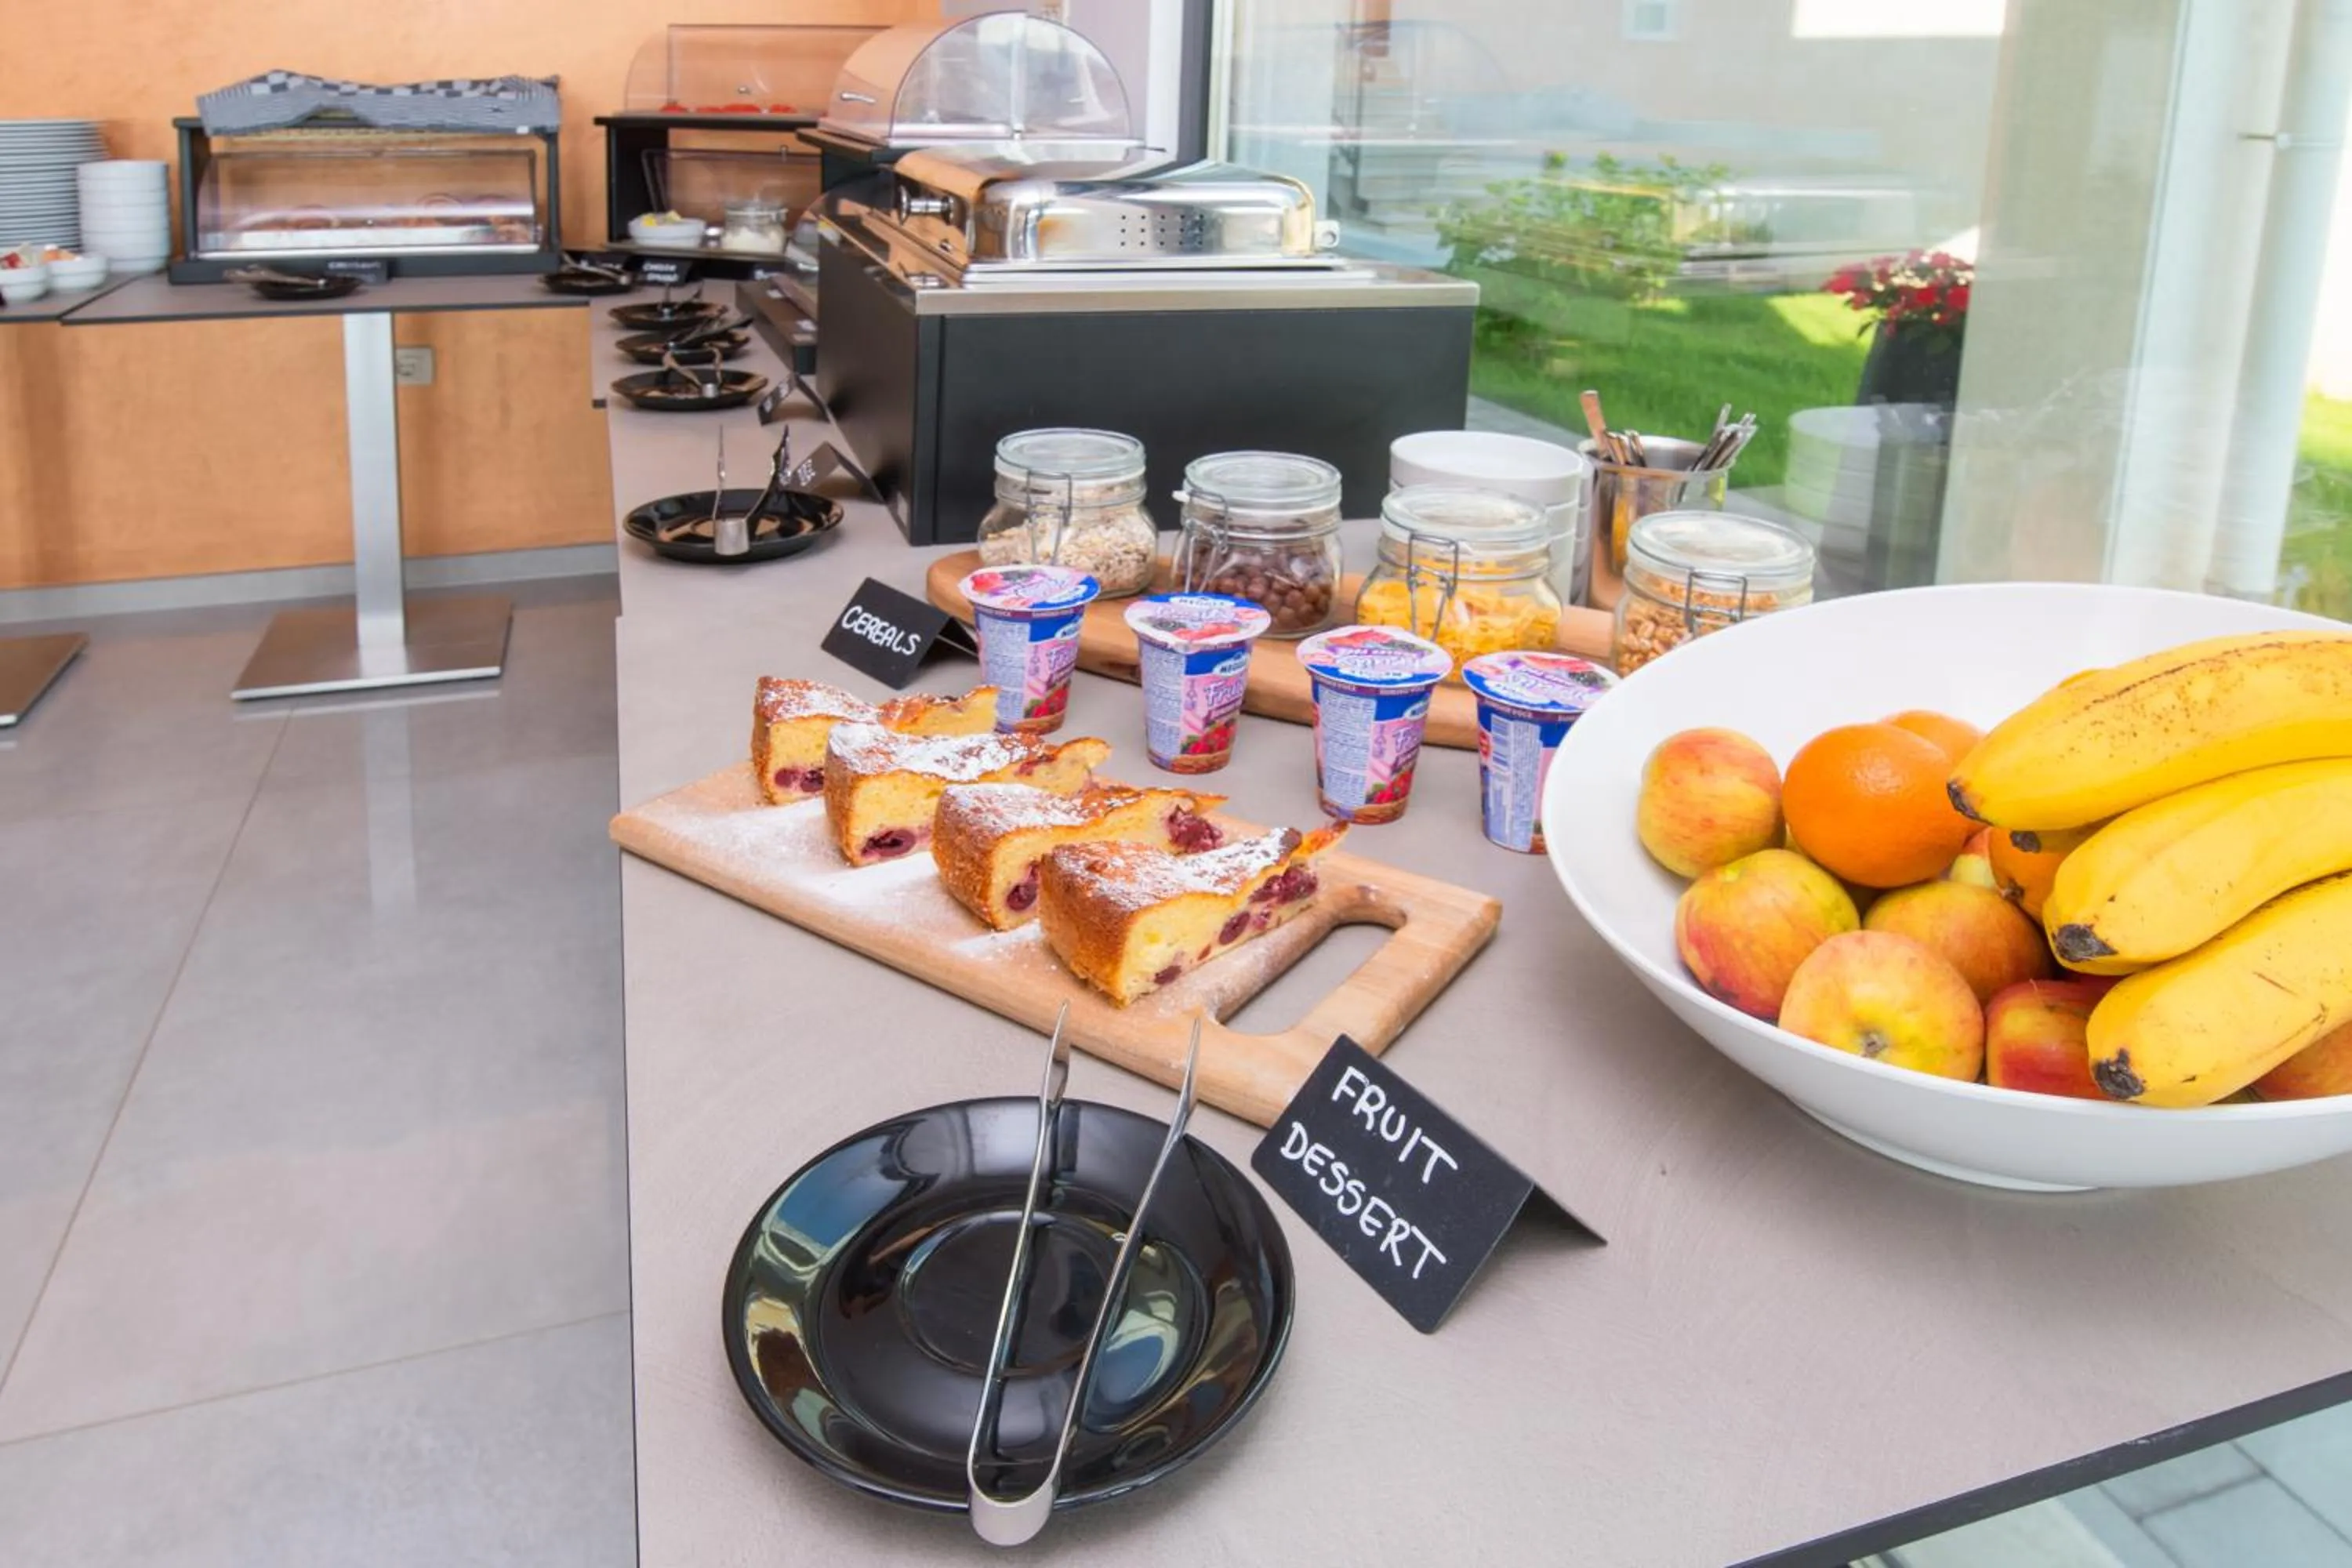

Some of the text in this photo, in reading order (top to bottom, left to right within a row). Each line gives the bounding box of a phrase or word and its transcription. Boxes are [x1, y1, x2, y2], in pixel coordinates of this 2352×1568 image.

[842, 605, 920, 655] CEREALS
[1331, 1065, 1458, 1184] FRUIT
[1279, 1121, 1447, 1279] DESSERT
